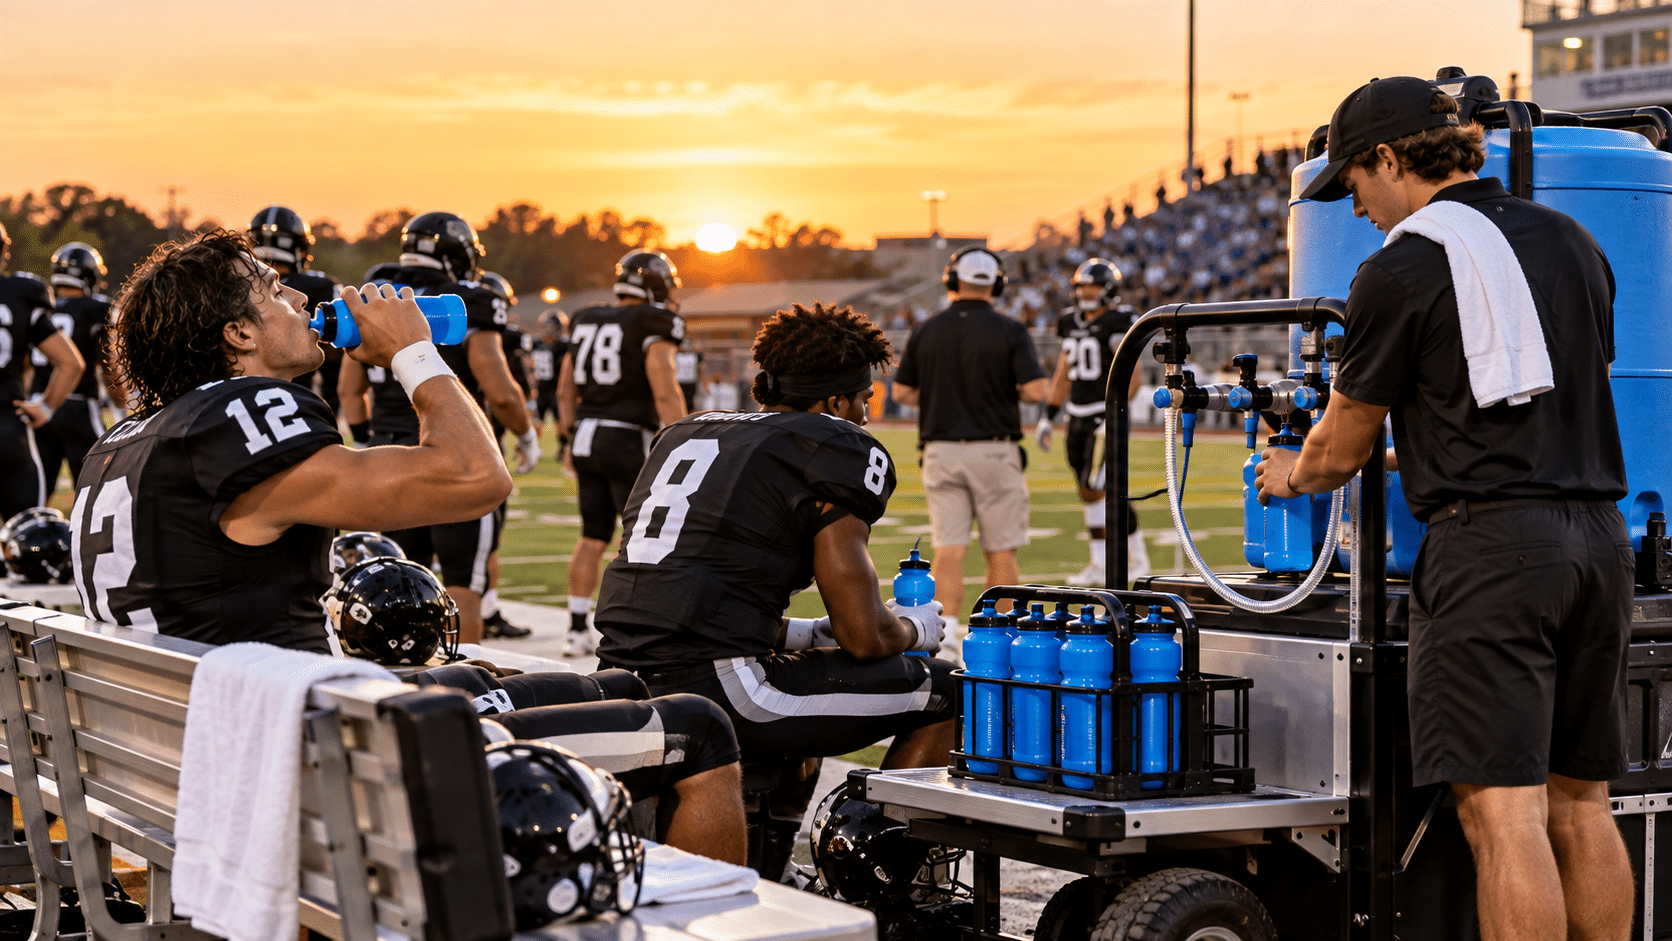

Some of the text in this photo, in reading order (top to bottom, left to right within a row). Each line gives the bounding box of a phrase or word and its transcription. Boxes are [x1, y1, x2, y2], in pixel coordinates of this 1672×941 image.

[571, 323, 623, 385] 78
[1062, 336, 1102, 381] 20
[225, 387, 312, 456] 12
[626, 438, 720, 565] 8
[864, 446, 888, 496] 8
[69, 475, 159, 634] 12
